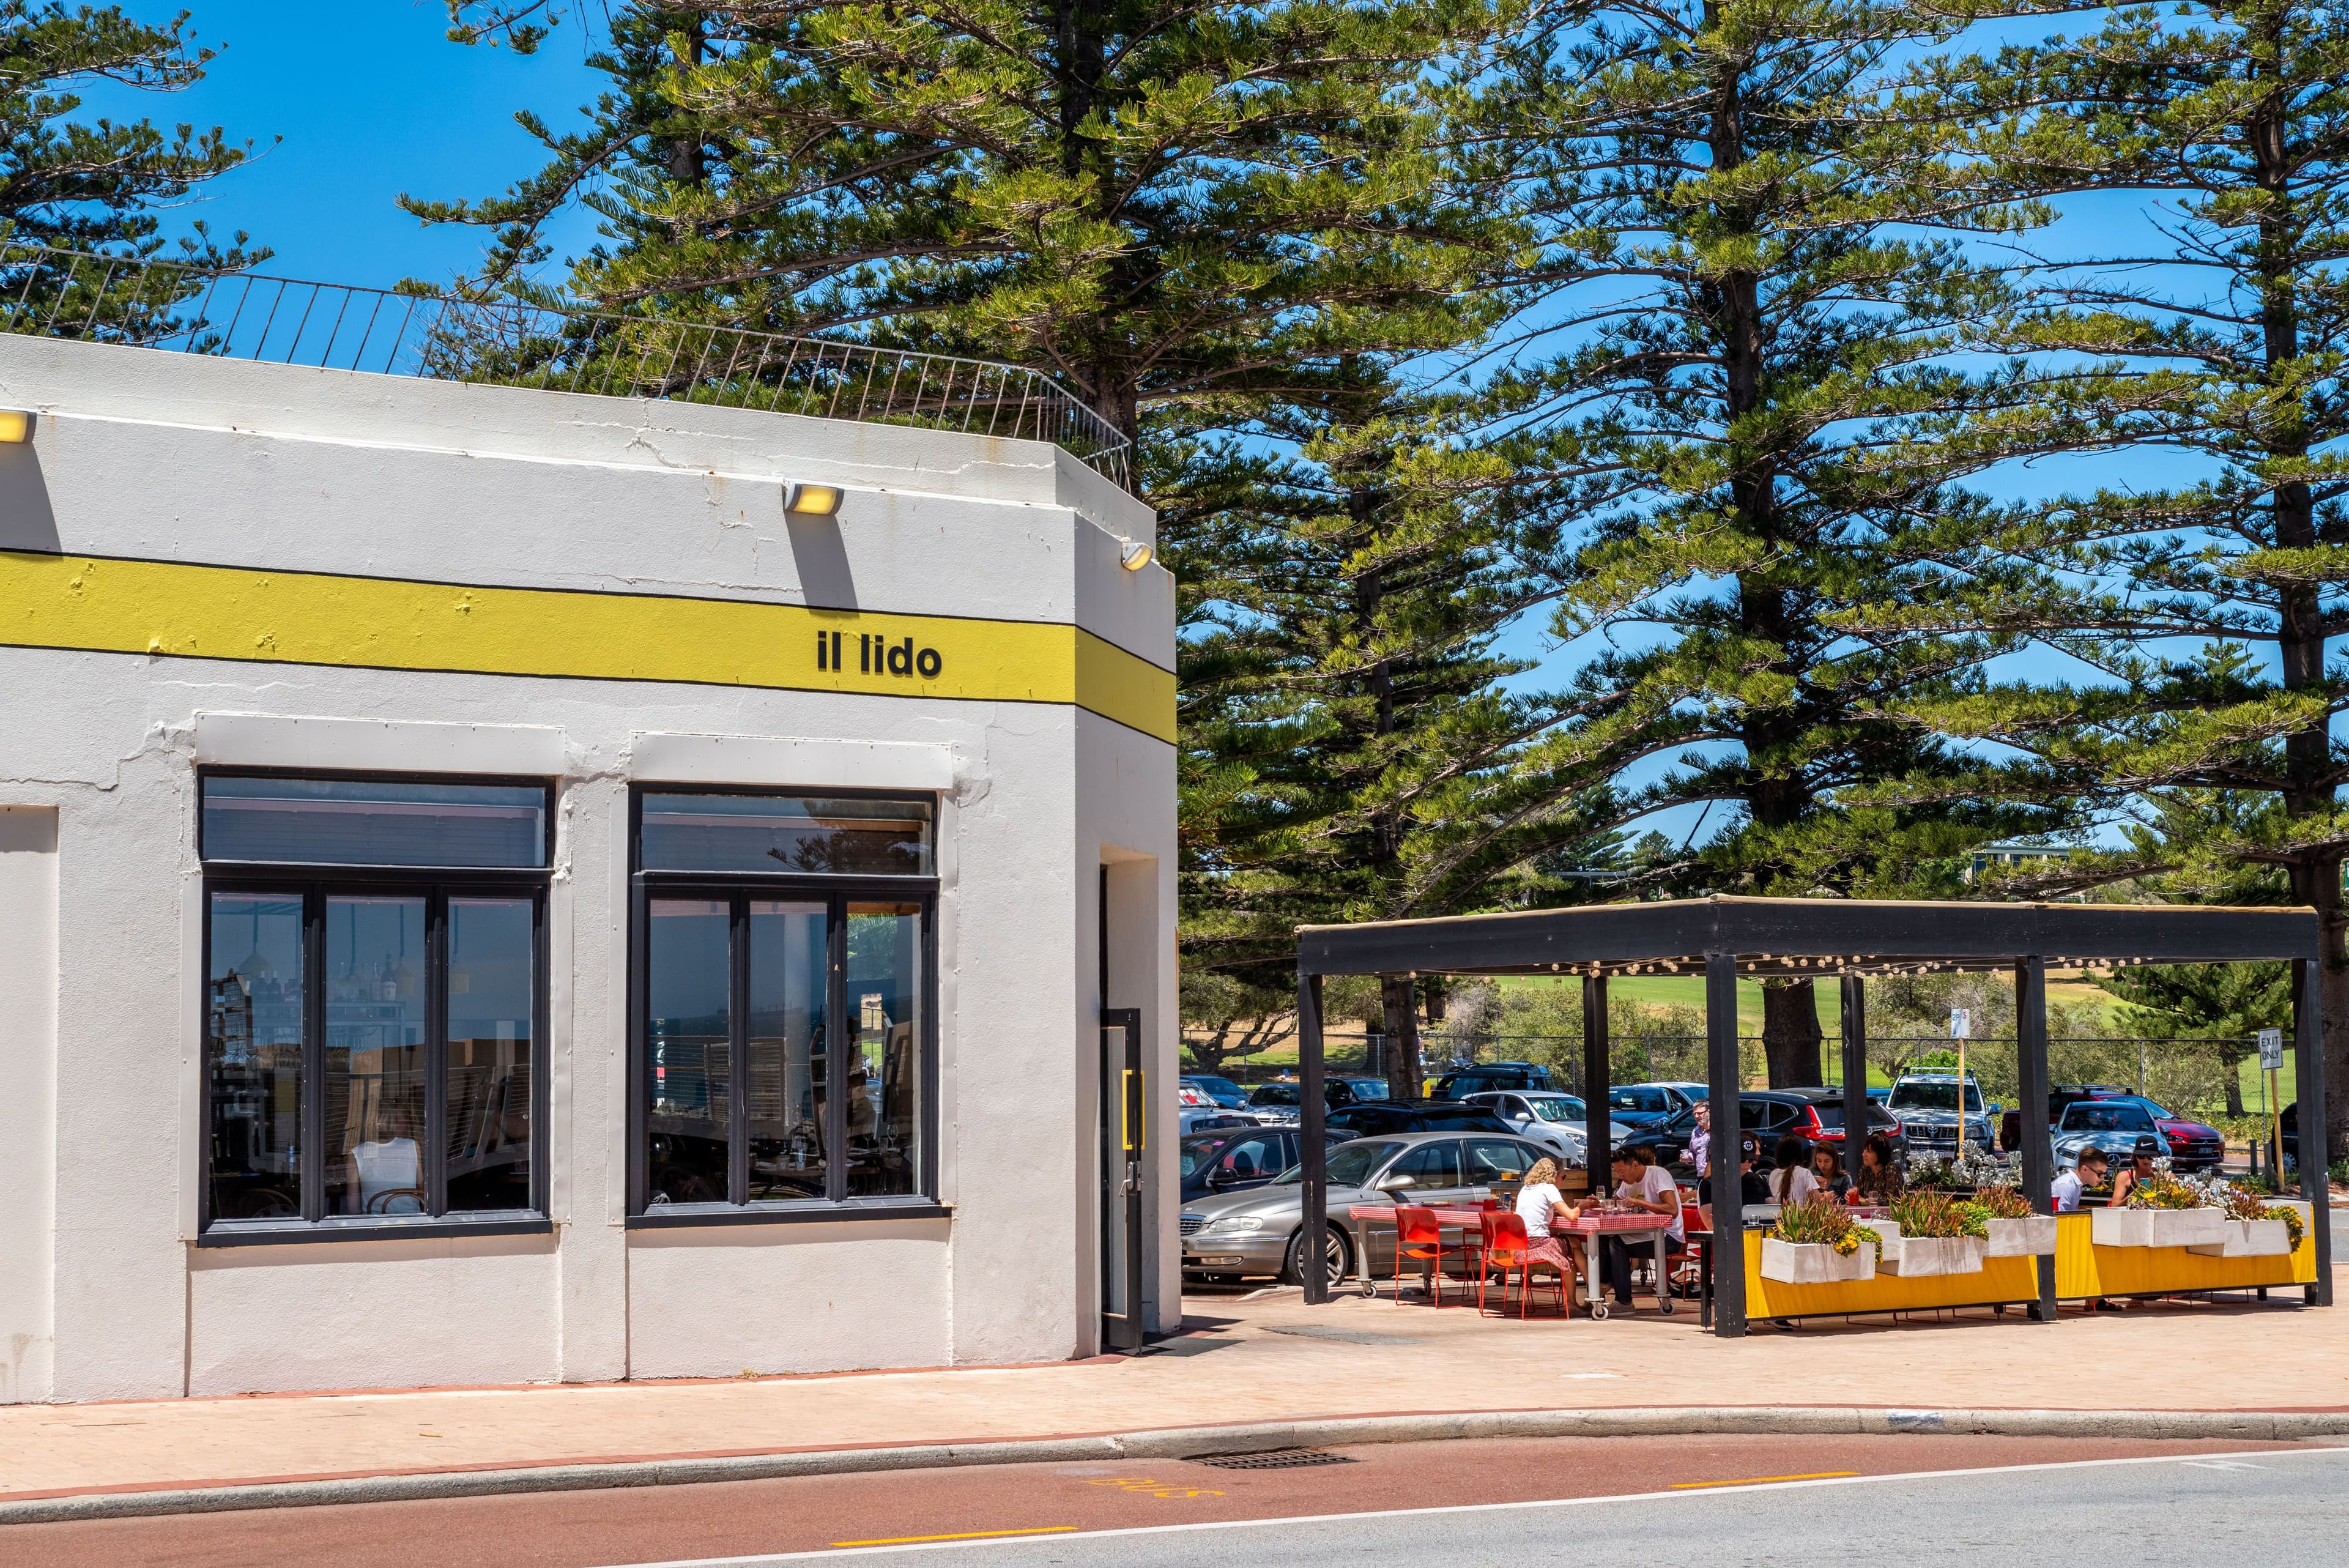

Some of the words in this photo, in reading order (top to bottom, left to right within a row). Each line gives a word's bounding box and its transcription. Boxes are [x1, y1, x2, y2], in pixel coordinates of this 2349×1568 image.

[818, 630, 841, 671] il
[861, 634, 942, 677] lido
[2261, 1036, 2279, 1047] EXIT
[2262, 1049, 2280, 1060] ONLY
[1081, 1477, 1226, 1498] BUS
